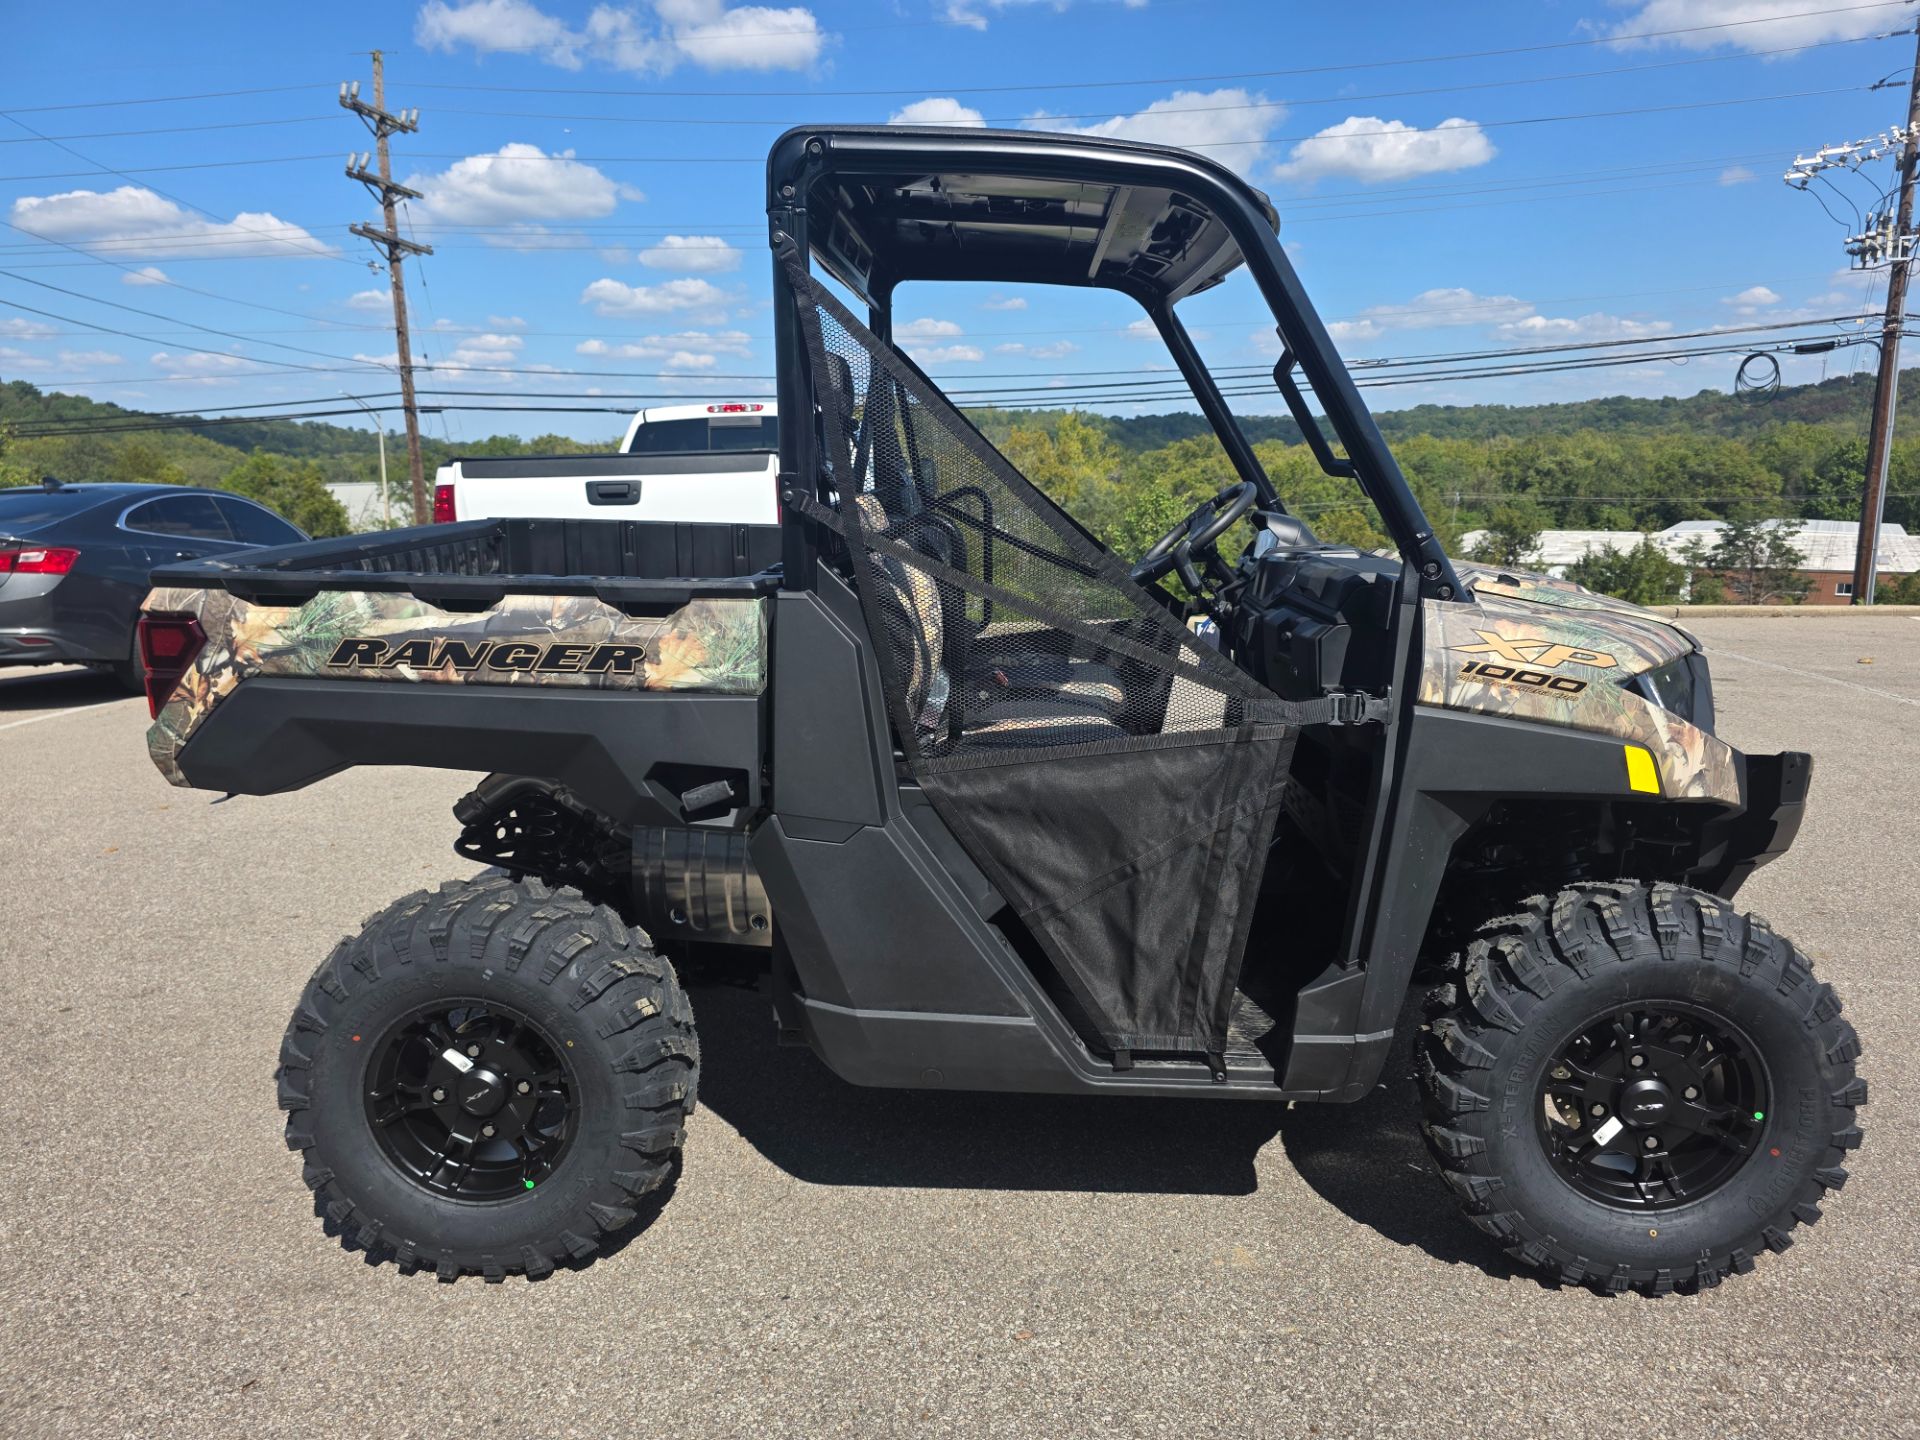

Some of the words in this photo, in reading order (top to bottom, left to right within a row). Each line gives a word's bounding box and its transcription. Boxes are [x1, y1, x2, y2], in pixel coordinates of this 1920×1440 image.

[327, 637, 647, 674] RANGER
[1446, 628, 1619, 668] XP
[1460, 661, 1588, 694] 1000
